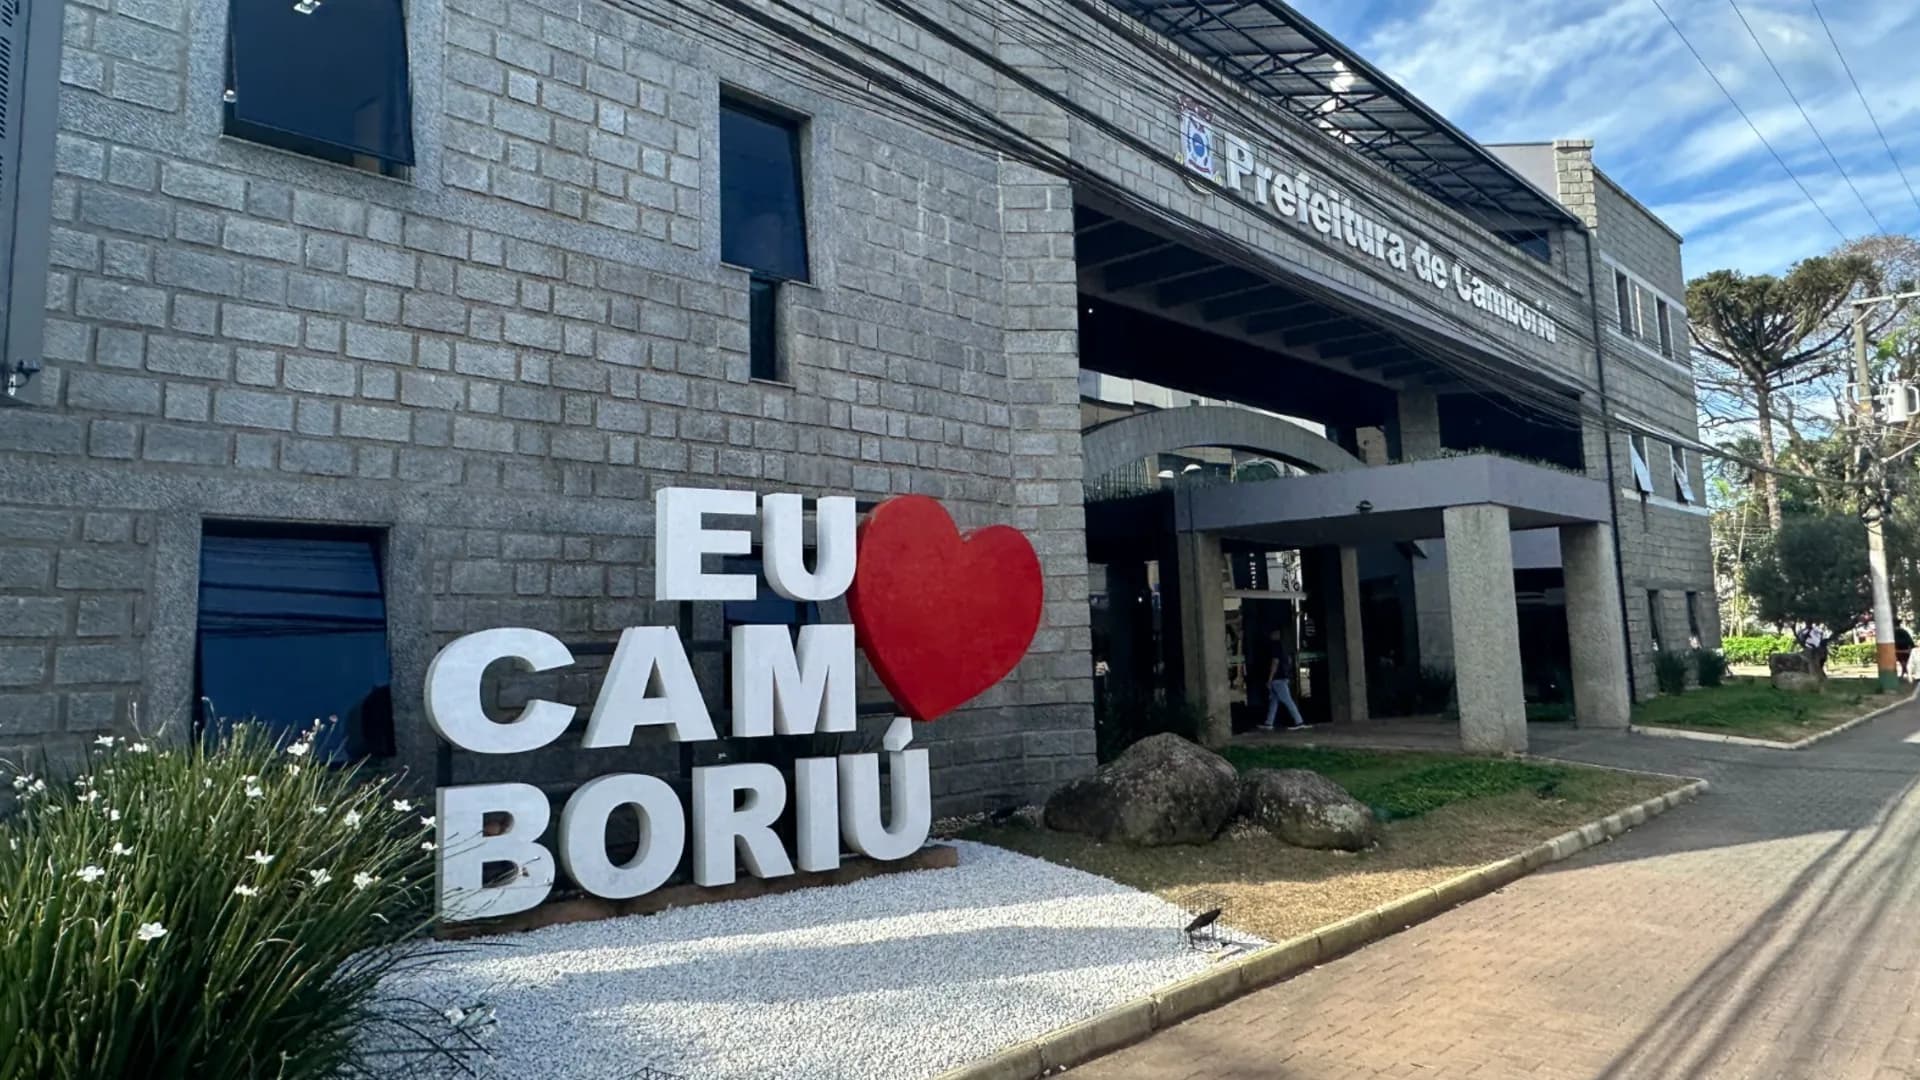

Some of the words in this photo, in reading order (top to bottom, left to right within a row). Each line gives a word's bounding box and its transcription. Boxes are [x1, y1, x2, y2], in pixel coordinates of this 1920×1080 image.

[1224, 132, 1407, 272] Prefeitura
[1411, 239, 1448, 289] de
[656, 487, 857, 602] EU
[424, 624, 858, 754] CAM
[436, 717, 932, 921] BORIÚ
